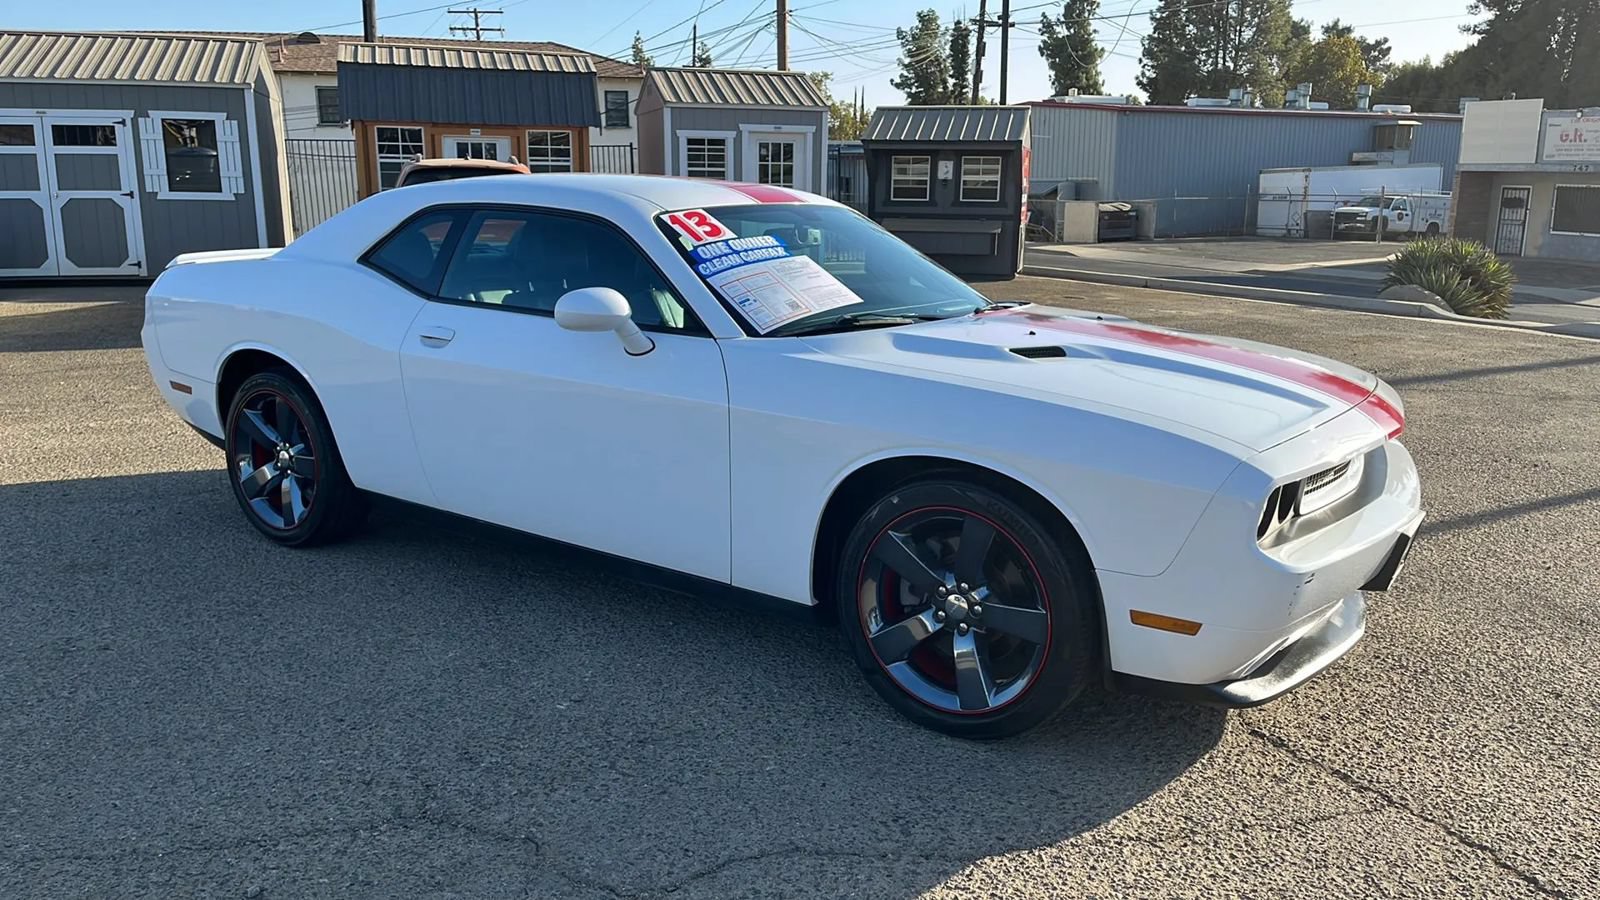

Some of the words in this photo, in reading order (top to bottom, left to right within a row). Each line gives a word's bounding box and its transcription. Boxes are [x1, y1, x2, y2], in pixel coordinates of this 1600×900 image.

[668, 211, 723, 243] 13
[697, 241, 732, 260] ONE
[728, 235, 778, 253] OWNER
[698, 253, 741, 276] CLEAN
[740, 246, 788, 263] CARFAX
